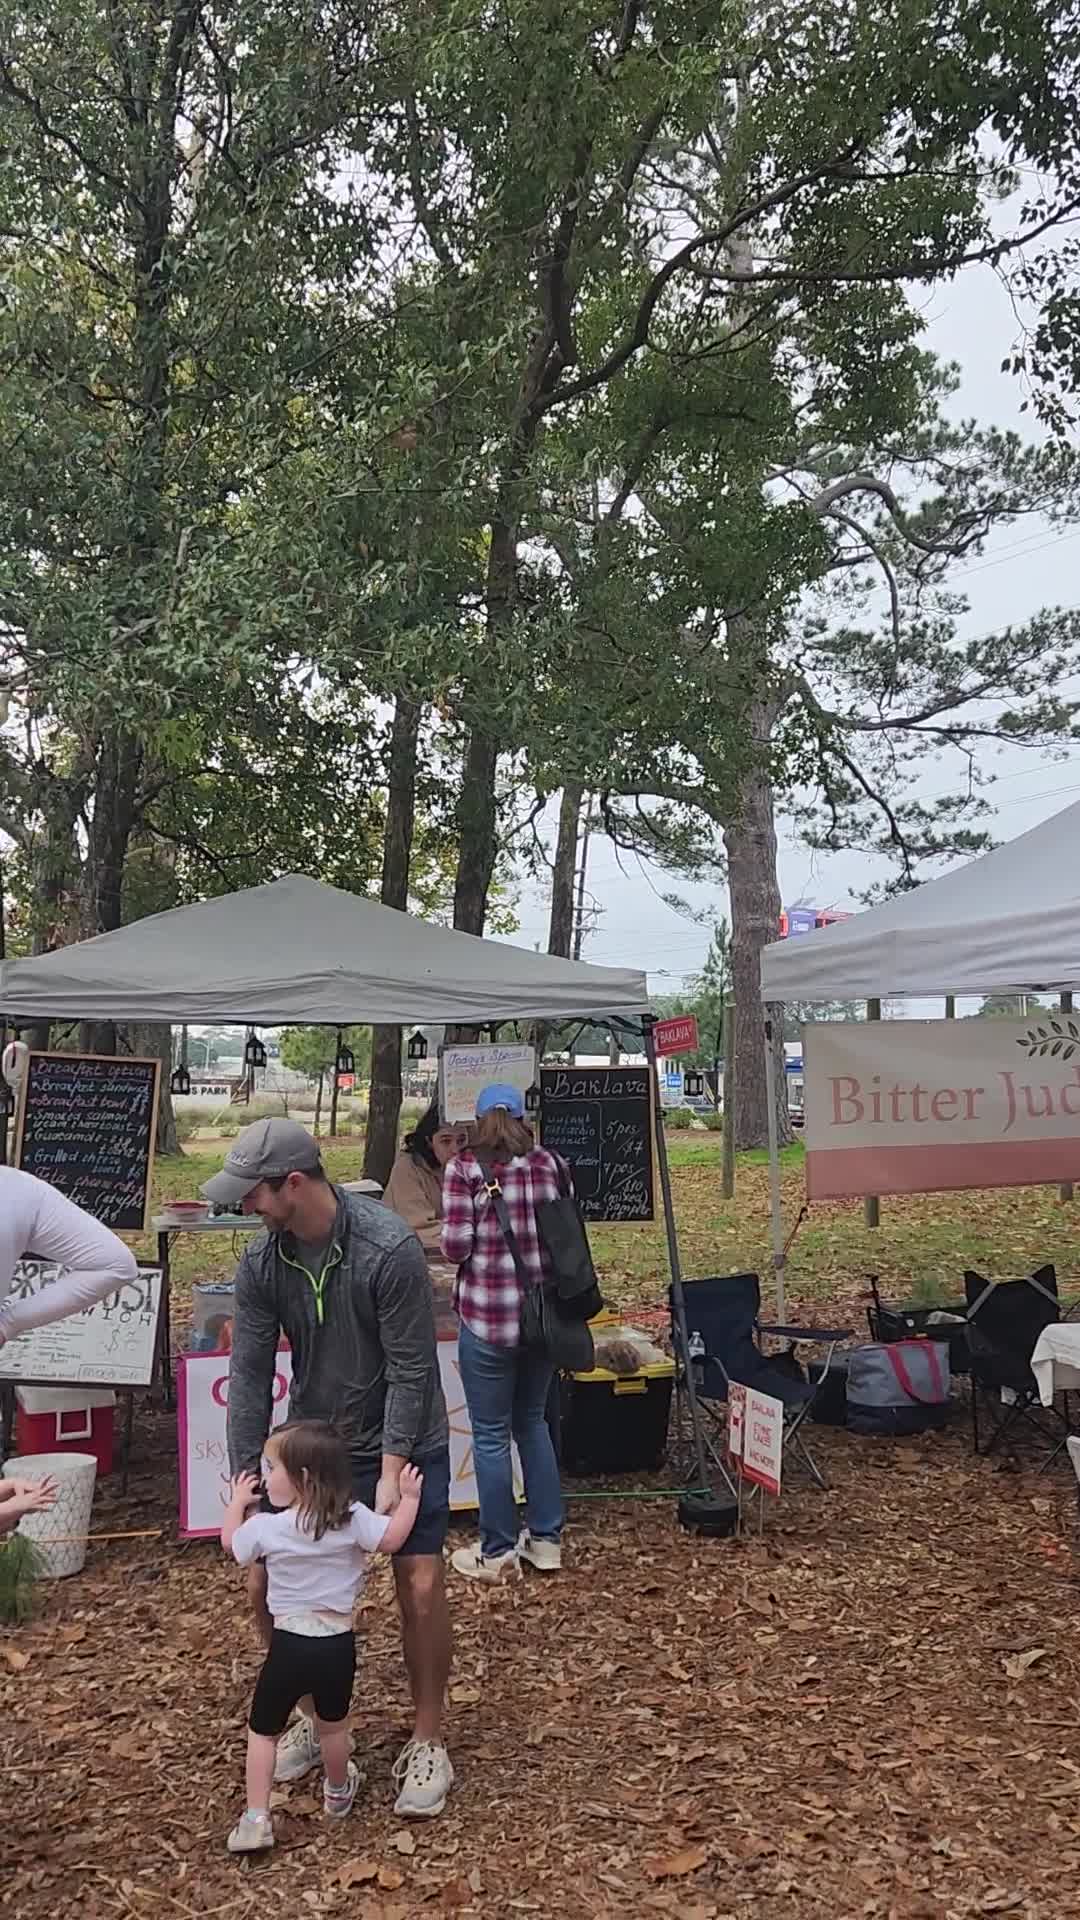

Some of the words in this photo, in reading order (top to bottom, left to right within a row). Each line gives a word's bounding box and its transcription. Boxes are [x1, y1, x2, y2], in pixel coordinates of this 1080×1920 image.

[201, 1086, 228, 1096] PARK
[544, 1071, 650, 1098] Baklava
[827, 1075, 985, 1126] Bitter
[33, 1109, 81, 1122] Smoked
[87, 1111, 128, 1121] salmon
[34, 1148, 79, 1163] Grilled
